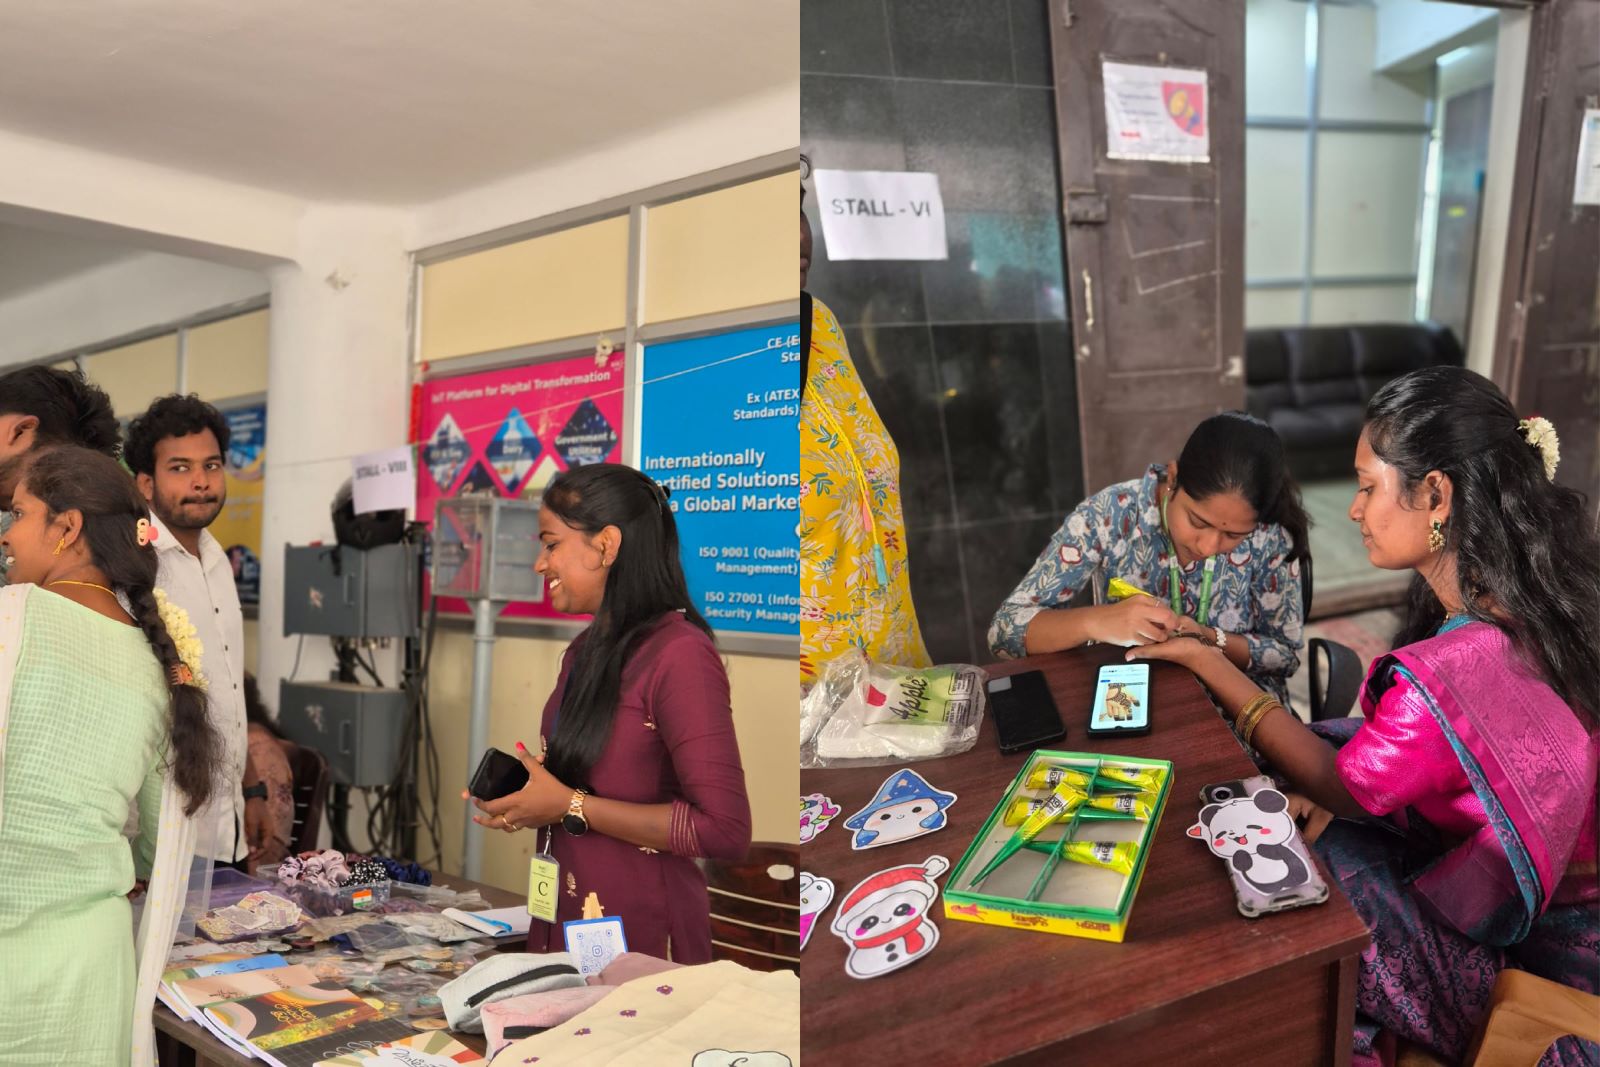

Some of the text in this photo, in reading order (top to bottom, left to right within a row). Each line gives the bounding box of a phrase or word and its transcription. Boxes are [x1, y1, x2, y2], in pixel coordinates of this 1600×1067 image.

[832, 198, 894, 217] STALL
[910, 200, 931, 217] VI
[767, 335, 800, 349] CE (E
[446, 389, 483, 402] Platform
[485, 386, 498, 396] for
[501, 380, 531, 396] Digital
[534, 371, 610, 390] Transformation
[747, 388, 799, 404] Ex (ATEX
[733, 404, 799, 421] Standards)
[555, 432, 608, 445] Government
[645, 448, 765, 470] Internationally
[651, 471, 799, 491] ertified Solutions
[684, 496, 736, 512] Global
[699, 546, 800, 561] ISO 9001 (Quality
[716, 562, 798, 576] Management)
[705, 592, 724, 602] ISO
[728, 592, 763, 604] 27001
[705, 607, 751, 622] Security
[538, 881, 548, 896] C
